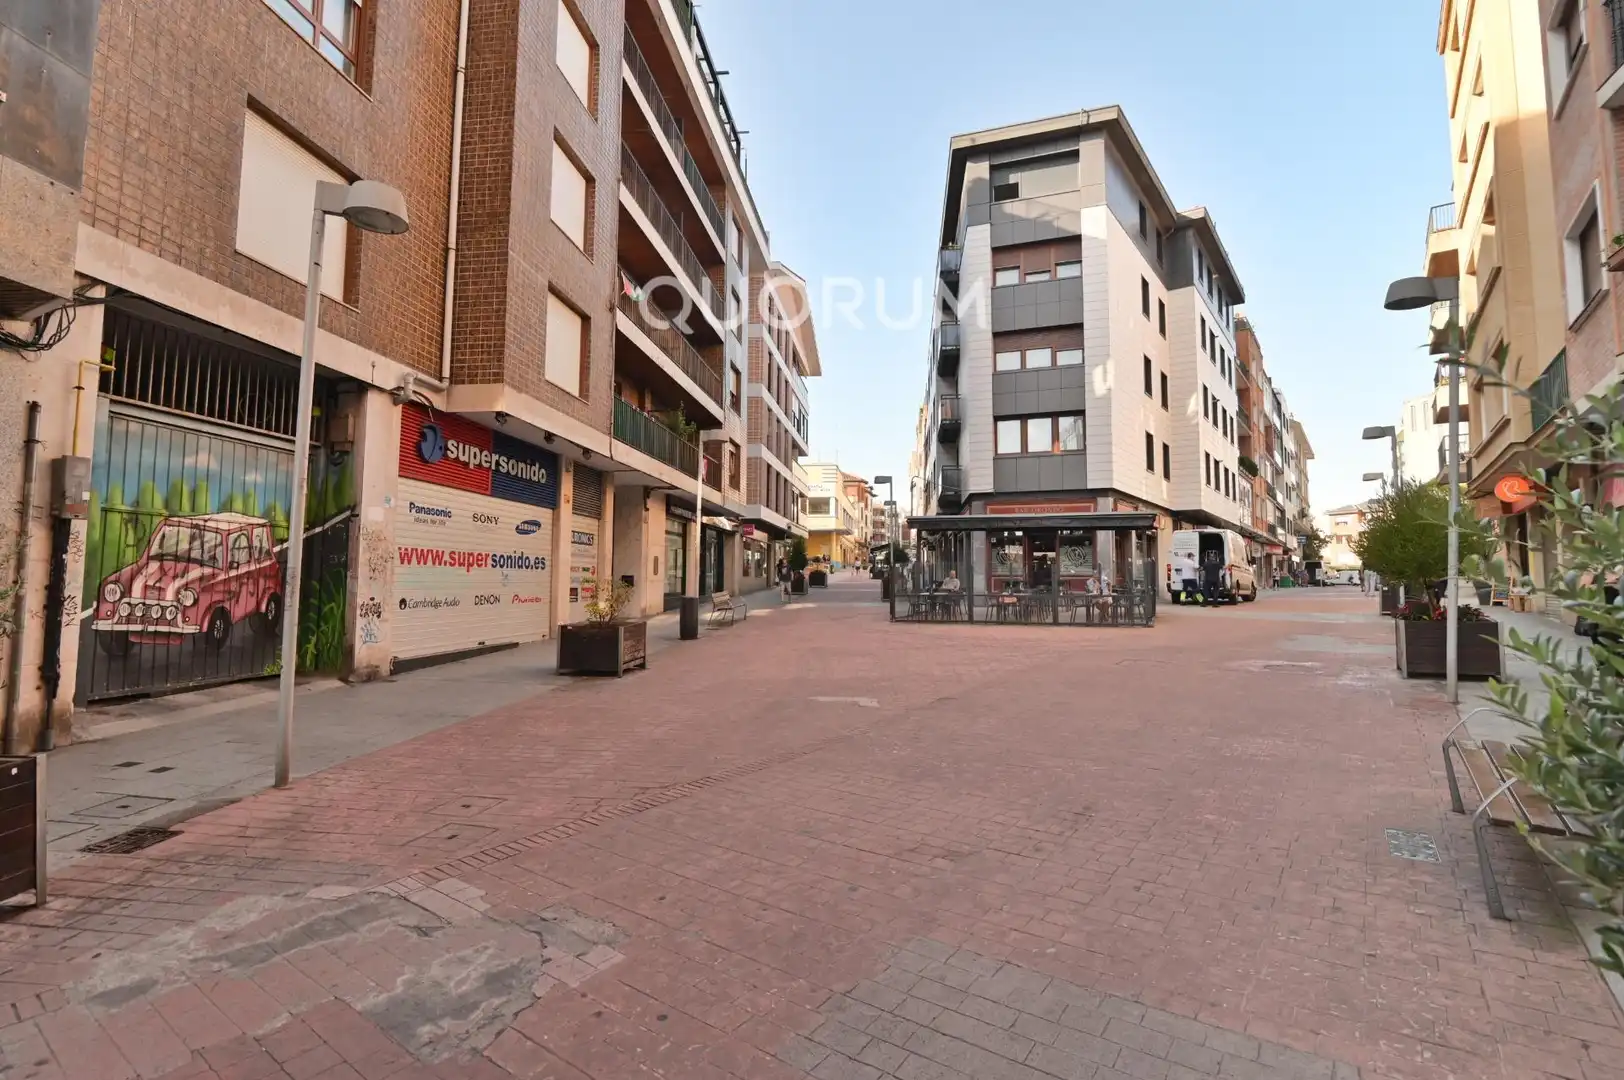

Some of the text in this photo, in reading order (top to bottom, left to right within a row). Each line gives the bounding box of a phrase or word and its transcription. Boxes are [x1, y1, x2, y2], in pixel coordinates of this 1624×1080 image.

[446, 439, 547, 484] supersonido
[409, 501, 452, 519] Panasonic
[472, 512, 500, 525] SONY
[398, 546, 546, 573] www.supersonido.es
[407, 597, 460, 610] Cambridge Audio
[474, 594, 500, 606] DENON
